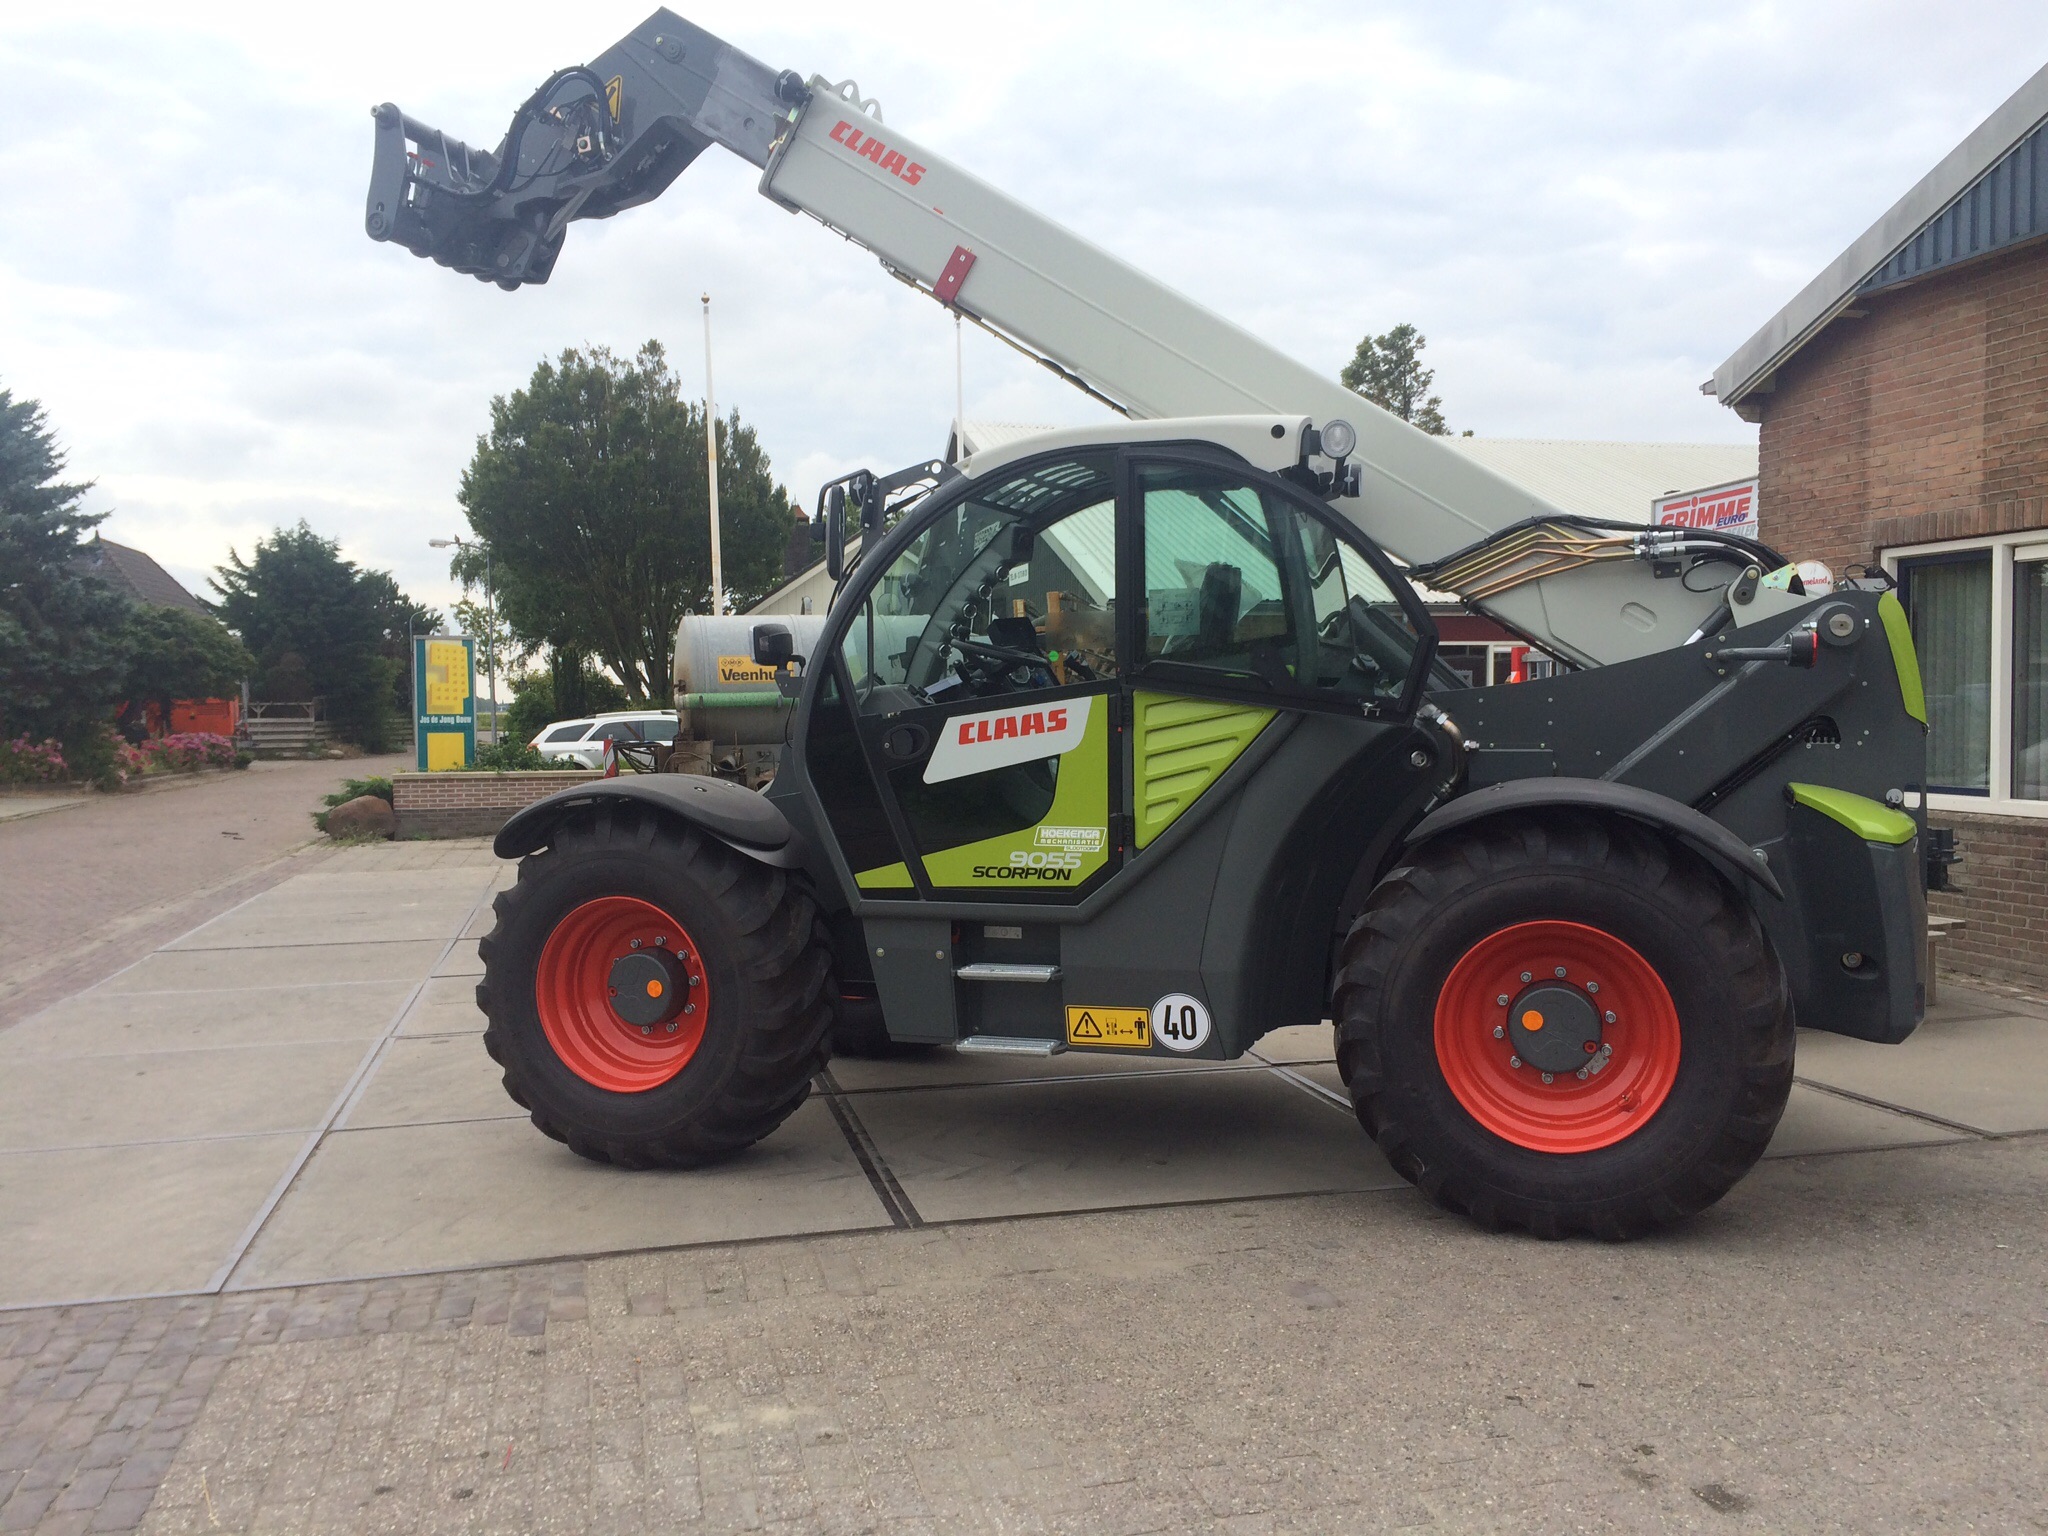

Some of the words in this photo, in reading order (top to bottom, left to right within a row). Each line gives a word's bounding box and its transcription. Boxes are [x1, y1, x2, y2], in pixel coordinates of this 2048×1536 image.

[828, 120, 927, 186] CLAAS
[1716, 512, 1747, 527] EURO
[721, 668, 777, 681] Veenhu
[420, 716, 430, 724] Jos
[431, 716, 438, 724] de
[439, 716, 454, 725] Jong
[958, 708, 1067, 745] CLAAS
[1040, 829, 1100, 839] HOEKENGA
[1009, 851, 1082, 869] 9055
[973, 866, 1072, 880] SCORPION
[1164, 1005, 1197, 1040] 40
